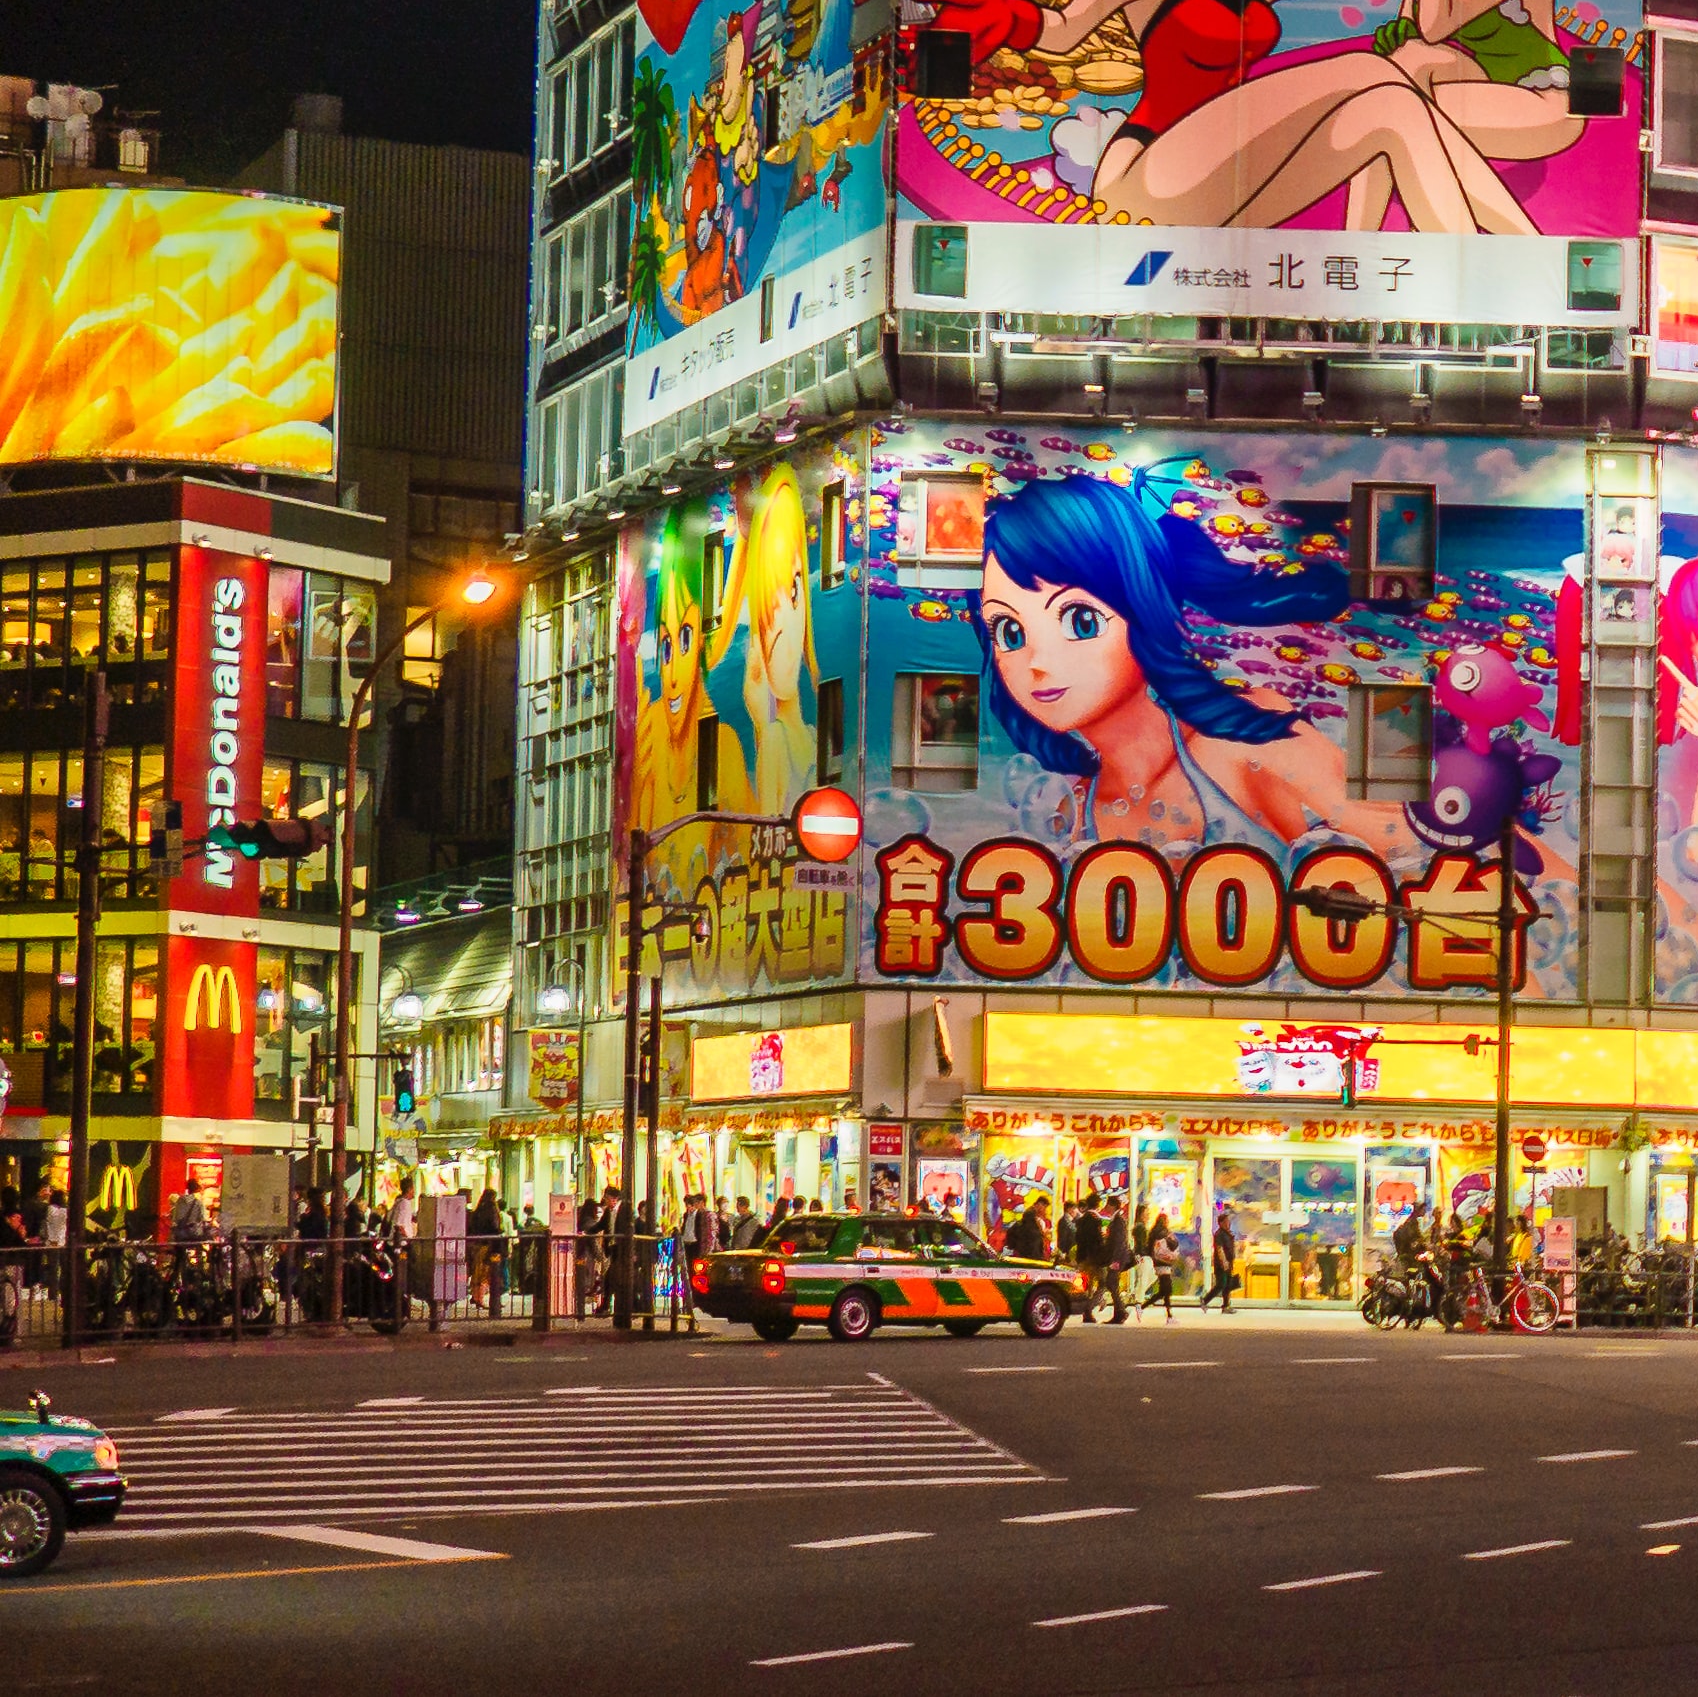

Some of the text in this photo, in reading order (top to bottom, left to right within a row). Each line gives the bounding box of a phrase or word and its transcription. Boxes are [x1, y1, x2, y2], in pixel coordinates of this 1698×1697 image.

[1173, 251, 1416, 292] 株式会社 北電子
